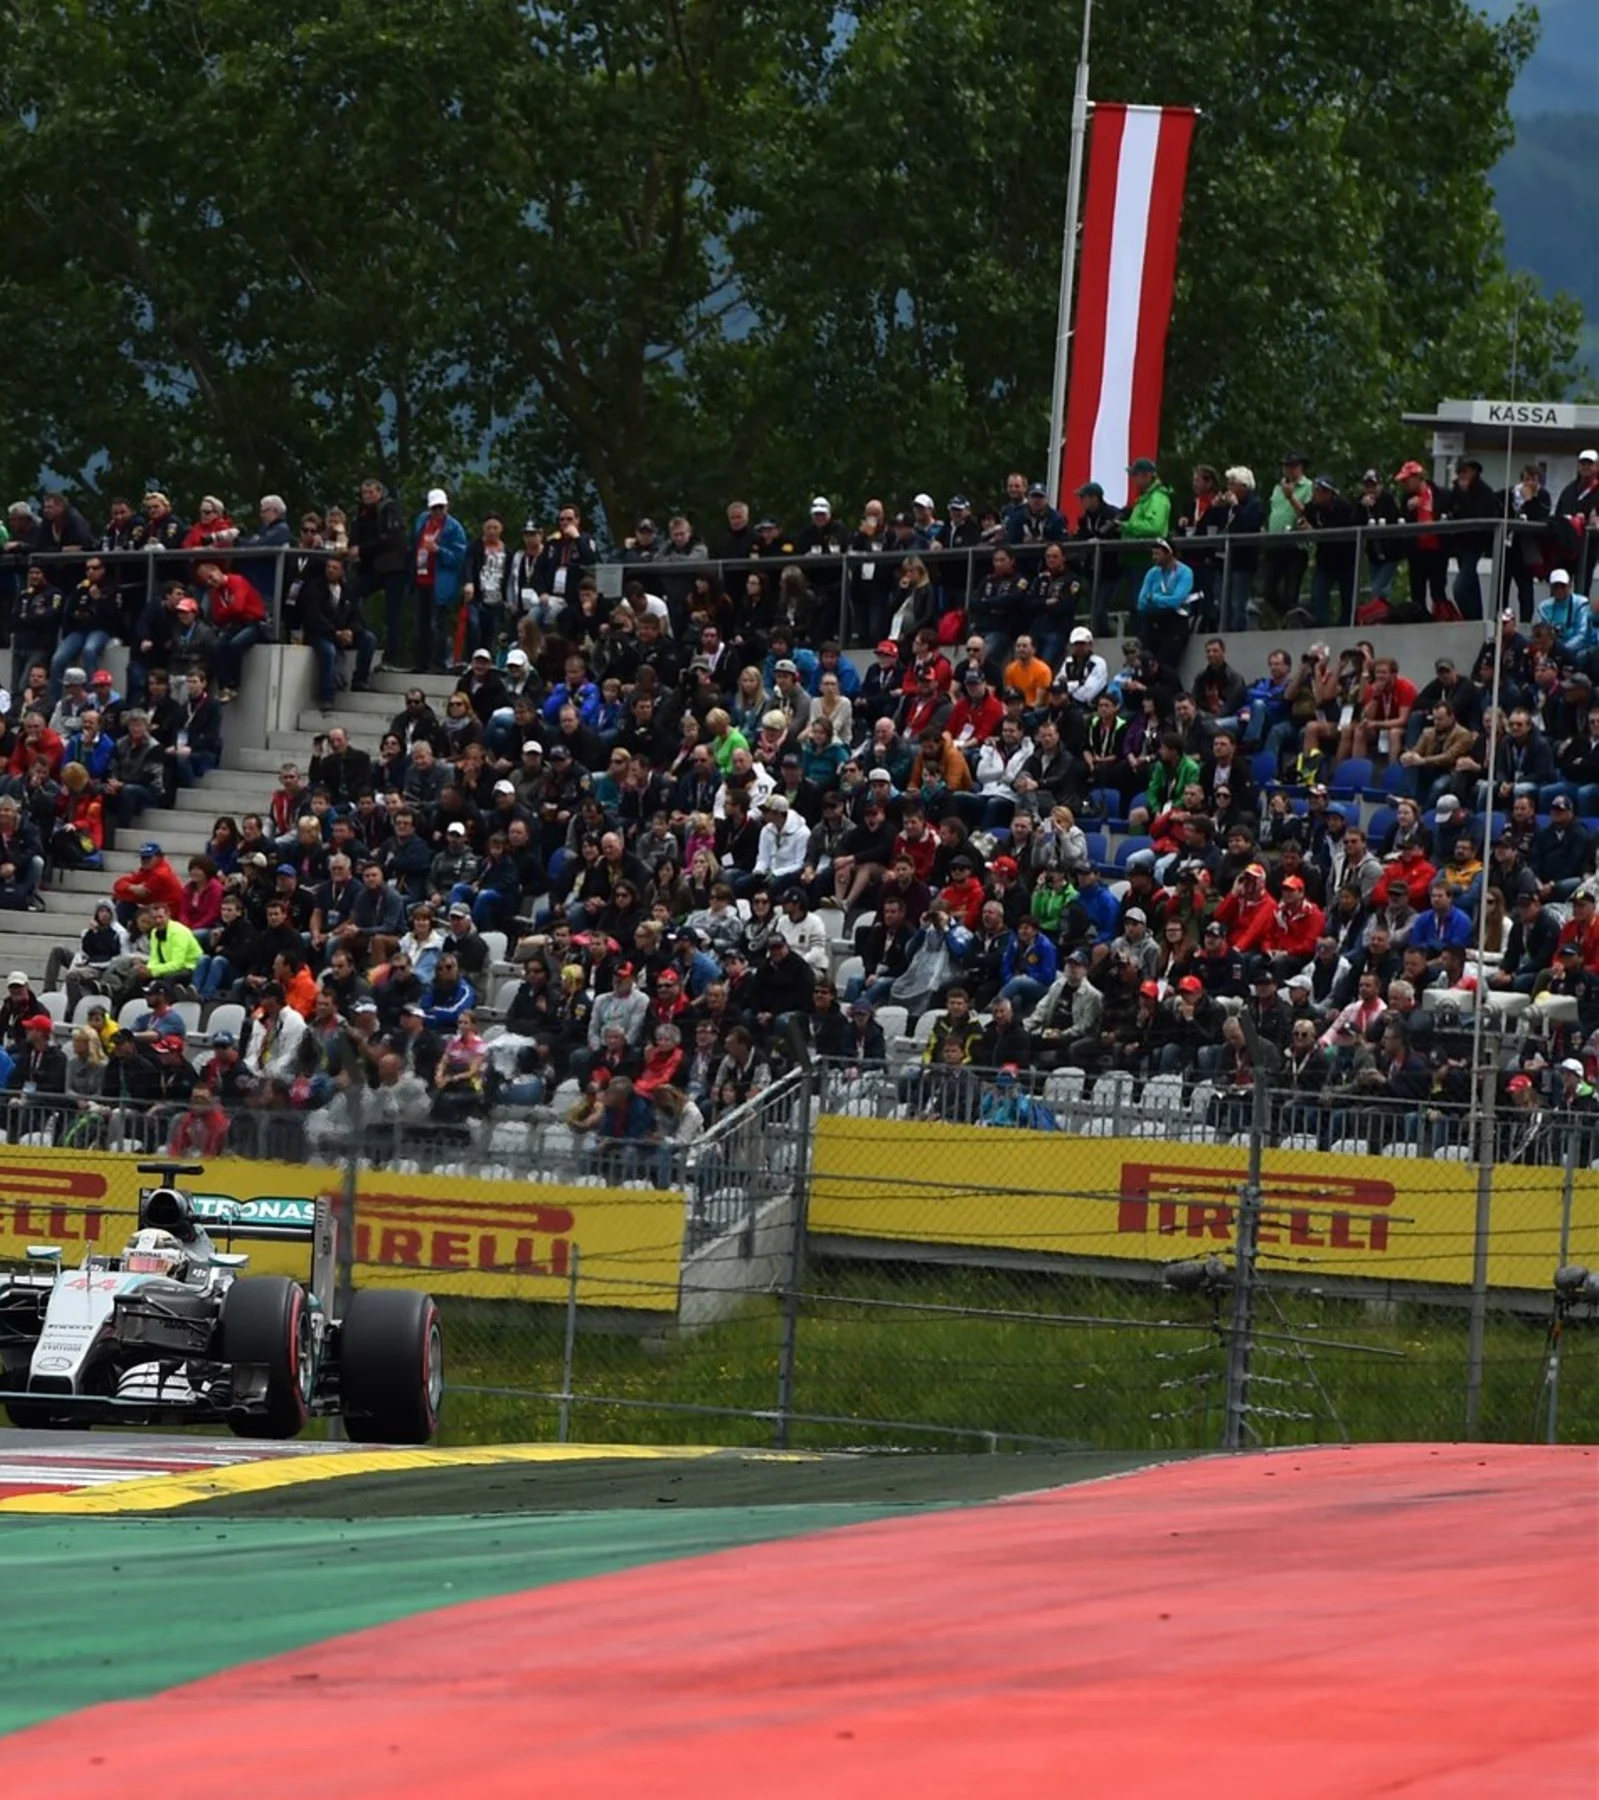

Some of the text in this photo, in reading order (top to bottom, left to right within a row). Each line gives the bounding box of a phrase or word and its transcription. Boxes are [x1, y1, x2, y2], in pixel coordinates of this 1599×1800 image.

[1488, 405, 1558, 424] KASSA
[1118, 1163, 1395, 1250] PIRELLI
[64, 1278, 117, 1292] 44
